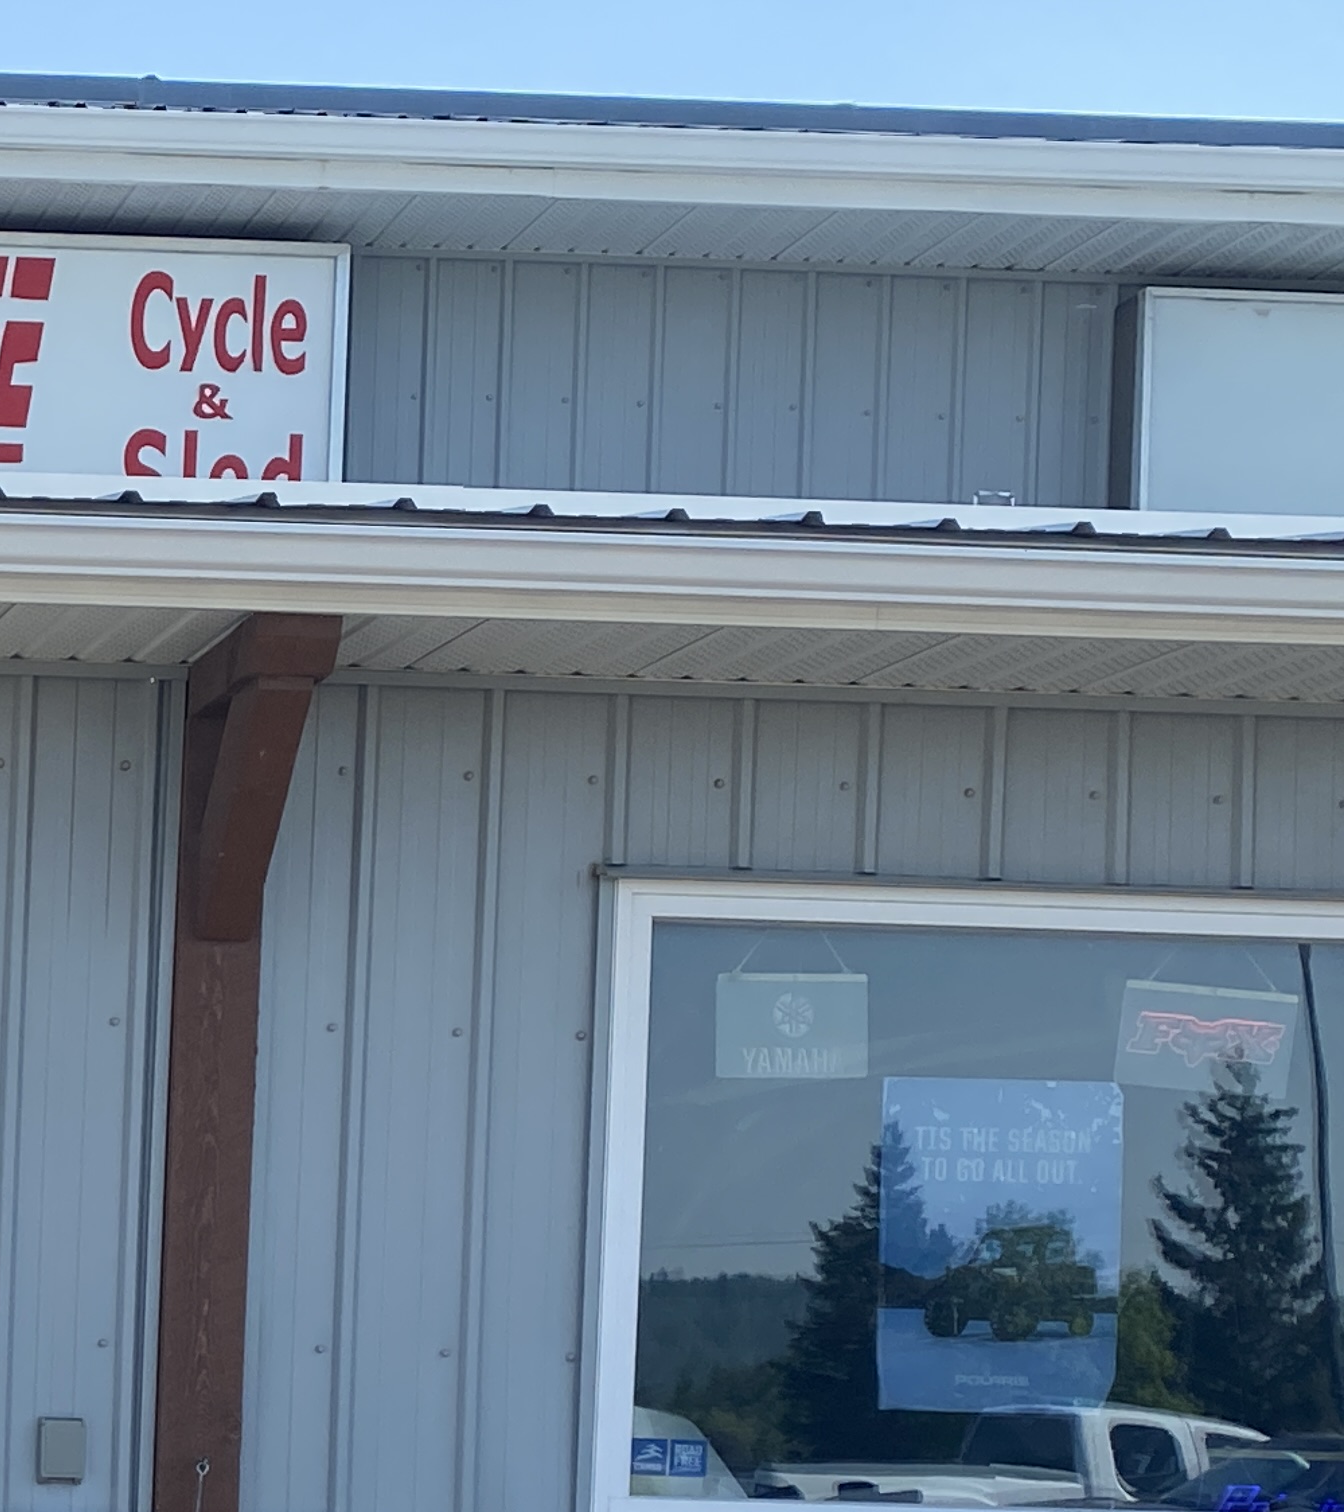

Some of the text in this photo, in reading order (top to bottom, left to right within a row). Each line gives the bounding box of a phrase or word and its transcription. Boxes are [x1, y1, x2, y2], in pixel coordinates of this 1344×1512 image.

[130, 270, 308, 376] Cycle
[193, 383, 234, 420] &
[959, 1127, 1000, 1152] THE
[1008, 1127, 1092, 1153] SEASON
[921, 1156, 947, 1181] TO
[956, 1157, 985, 1182] GO
[993, 1158, 1029, 1183] ALL
